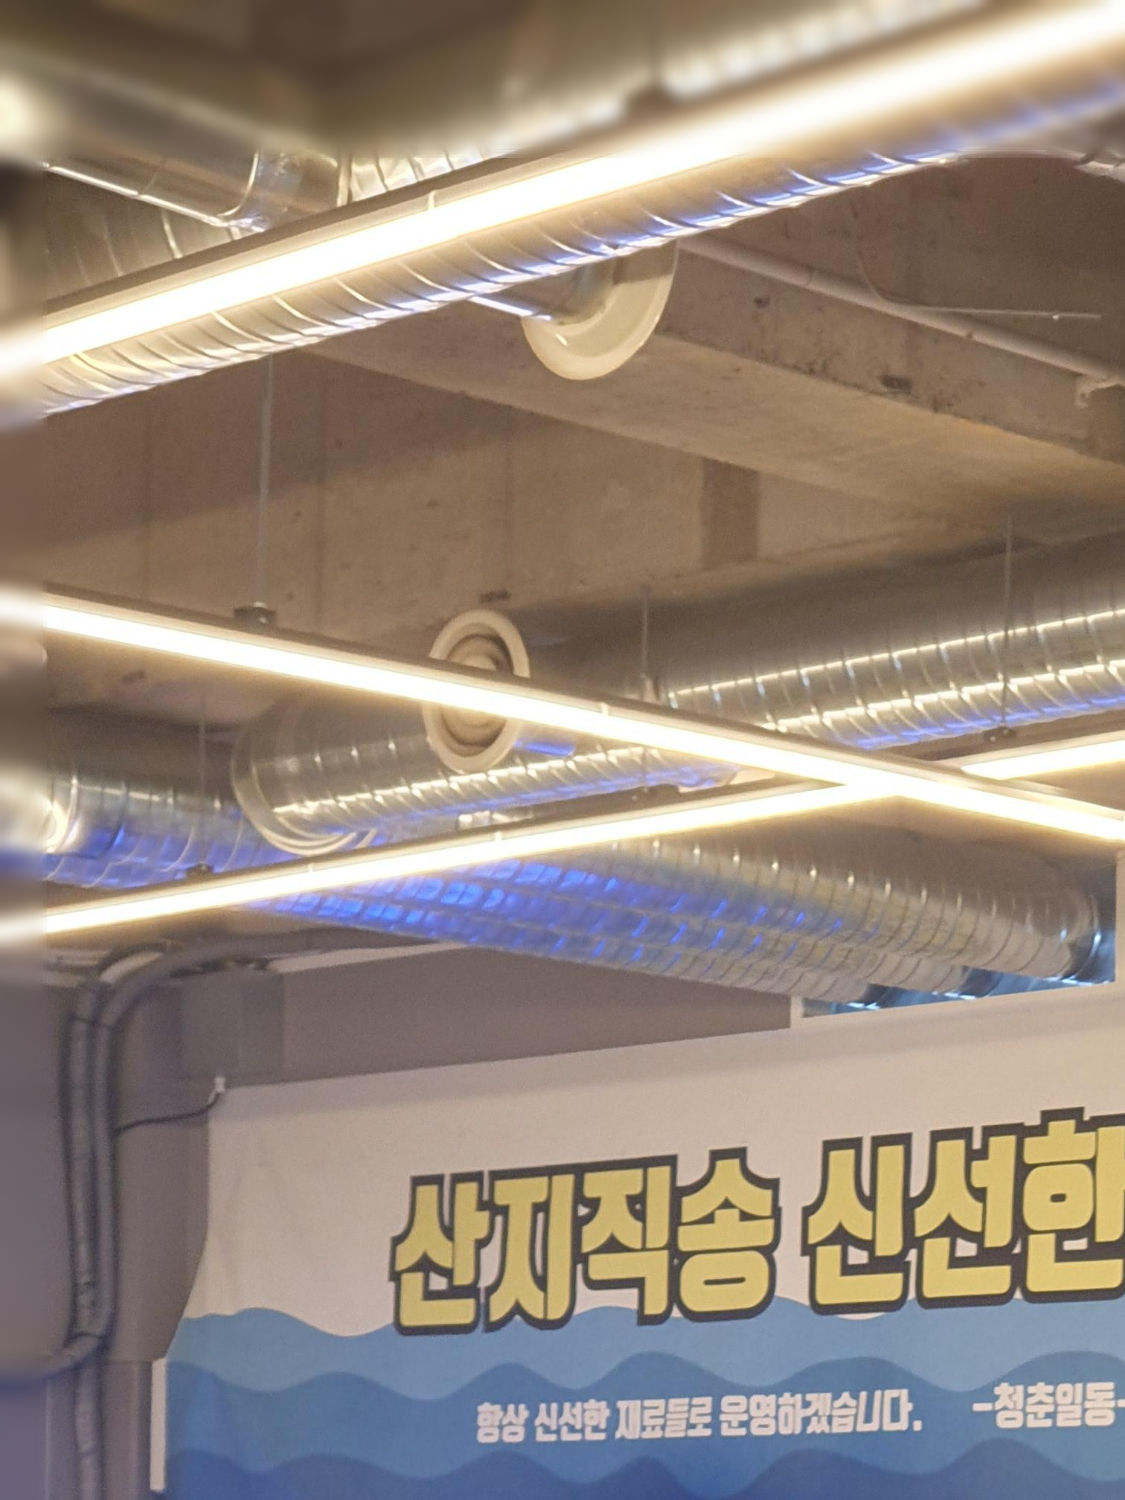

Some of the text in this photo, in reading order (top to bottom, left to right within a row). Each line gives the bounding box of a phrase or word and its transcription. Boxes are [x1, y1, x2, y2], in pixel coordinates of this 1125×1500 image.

[389, 1147, 781, 1336] 산지직송
[476, 1402, 529, 1443] 항상
[534, 1399, 610, 1442] 신선한
[615, 1396, 712, 1440] 재료들로
[719, 1388, 922, 1436] 운영하겠습니다.
